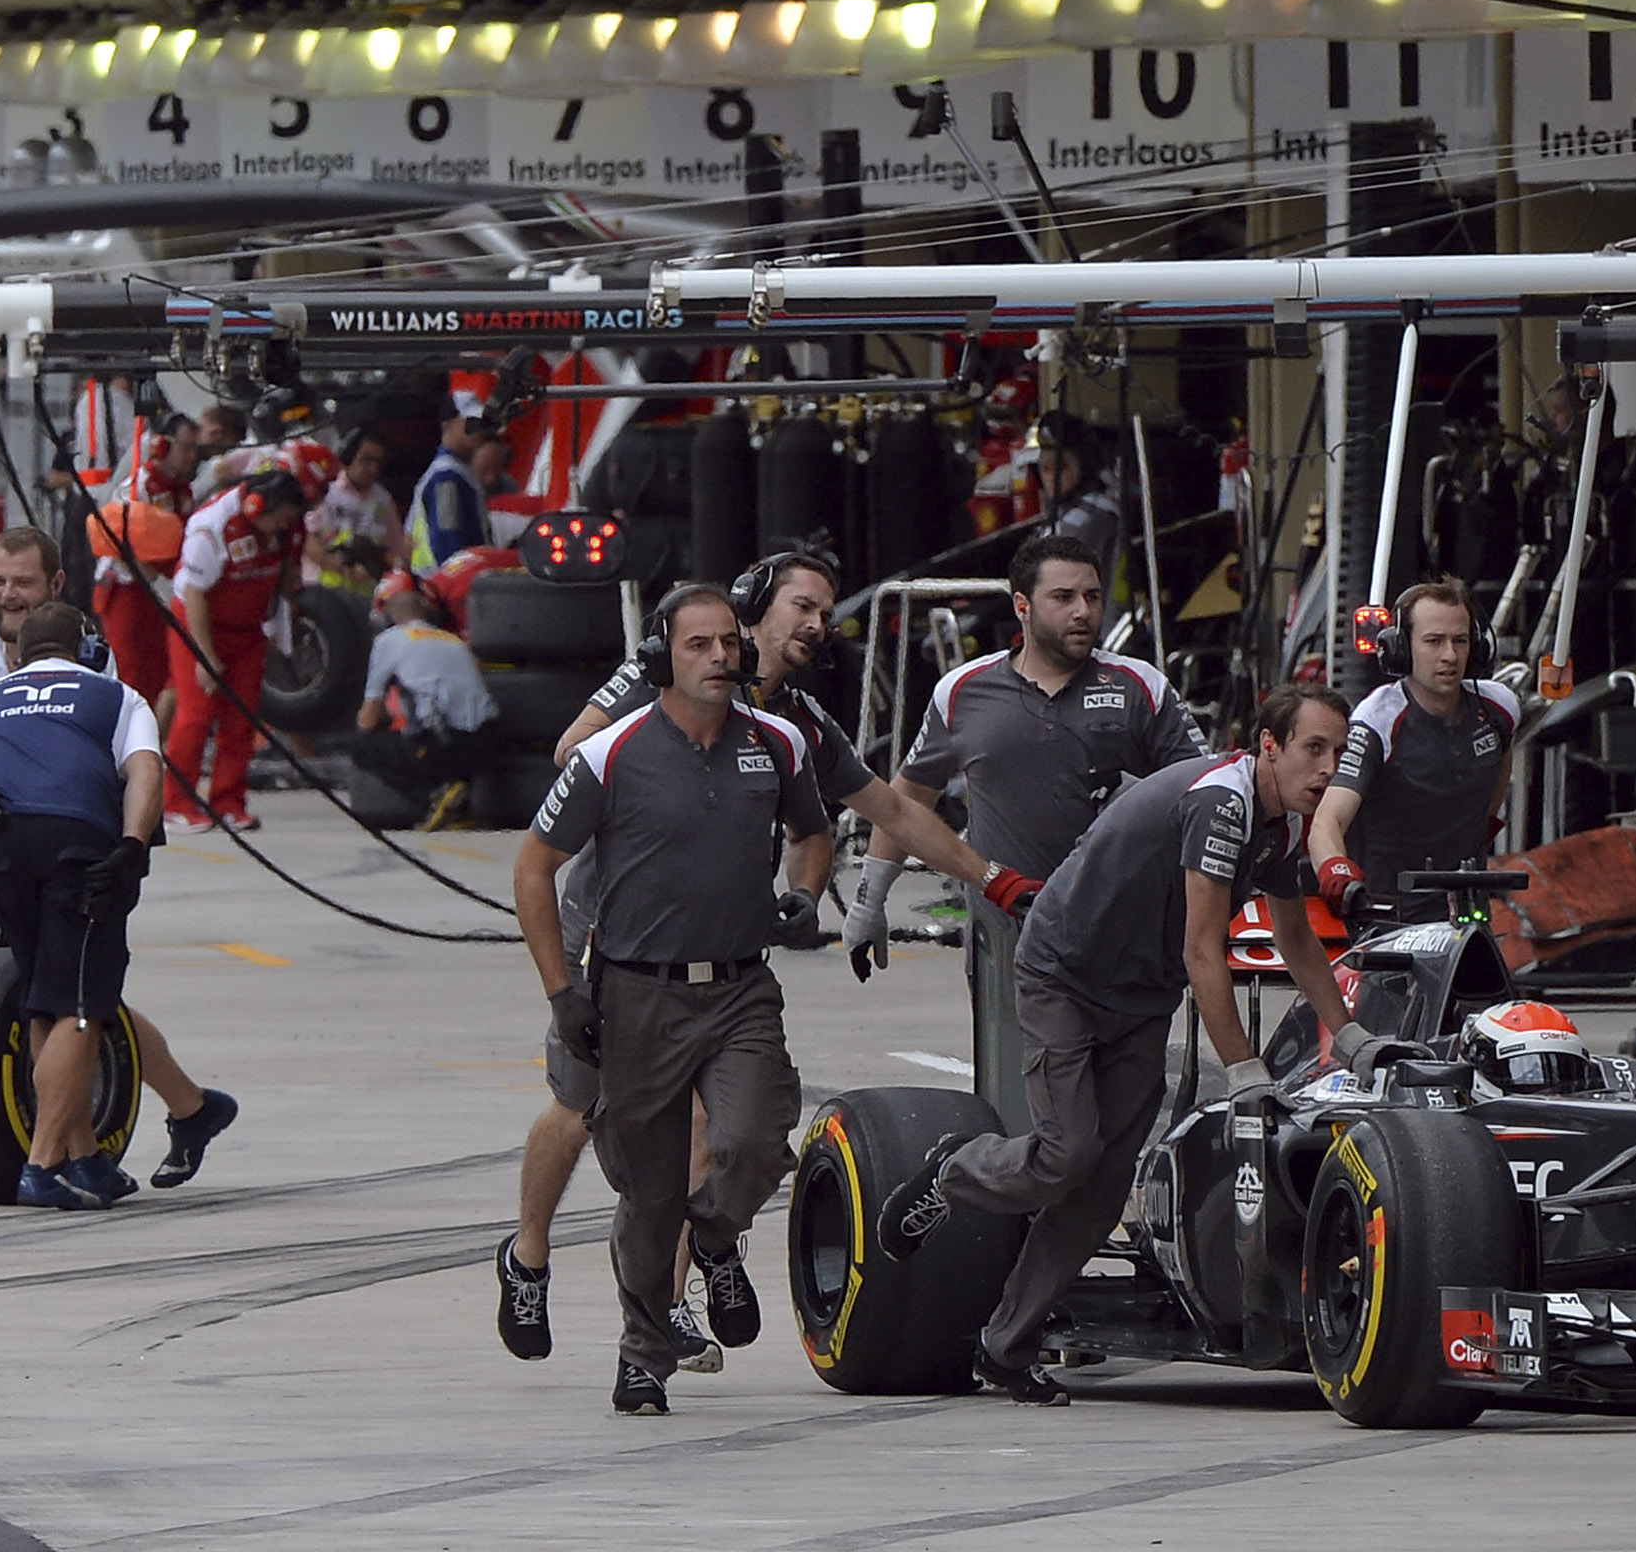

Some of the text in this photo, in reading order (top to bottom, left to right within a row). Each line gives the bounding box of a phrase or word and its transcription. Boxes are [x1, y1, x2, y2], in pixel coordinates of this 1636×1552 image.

[1092, 48, 1196, 120] 10
[147, 92, 191, 145] 4
[269, 95, 310, 139] 5
[705, 86, 754, 141] 8
[1048, 133, 1215, 170] Interlagos
[508, 153, 646, 186] Interlagos
[863, 154, 999, 190] nterlagos
[330, 307, 684, 332] WILLIAMS MARTINI RACIG
[0, 702, 75, 719] randstad
[1085, 695, 1125, 709] NEC
[1476, 735, 1499, 755] NE
[739, 756, 774, 772] NEC
[1394, 930, 1452, 953] oerlikon
[1540, 1032, 1568, 1041] Claro
[1501, 1354, 1542, 1377] TELMEX
